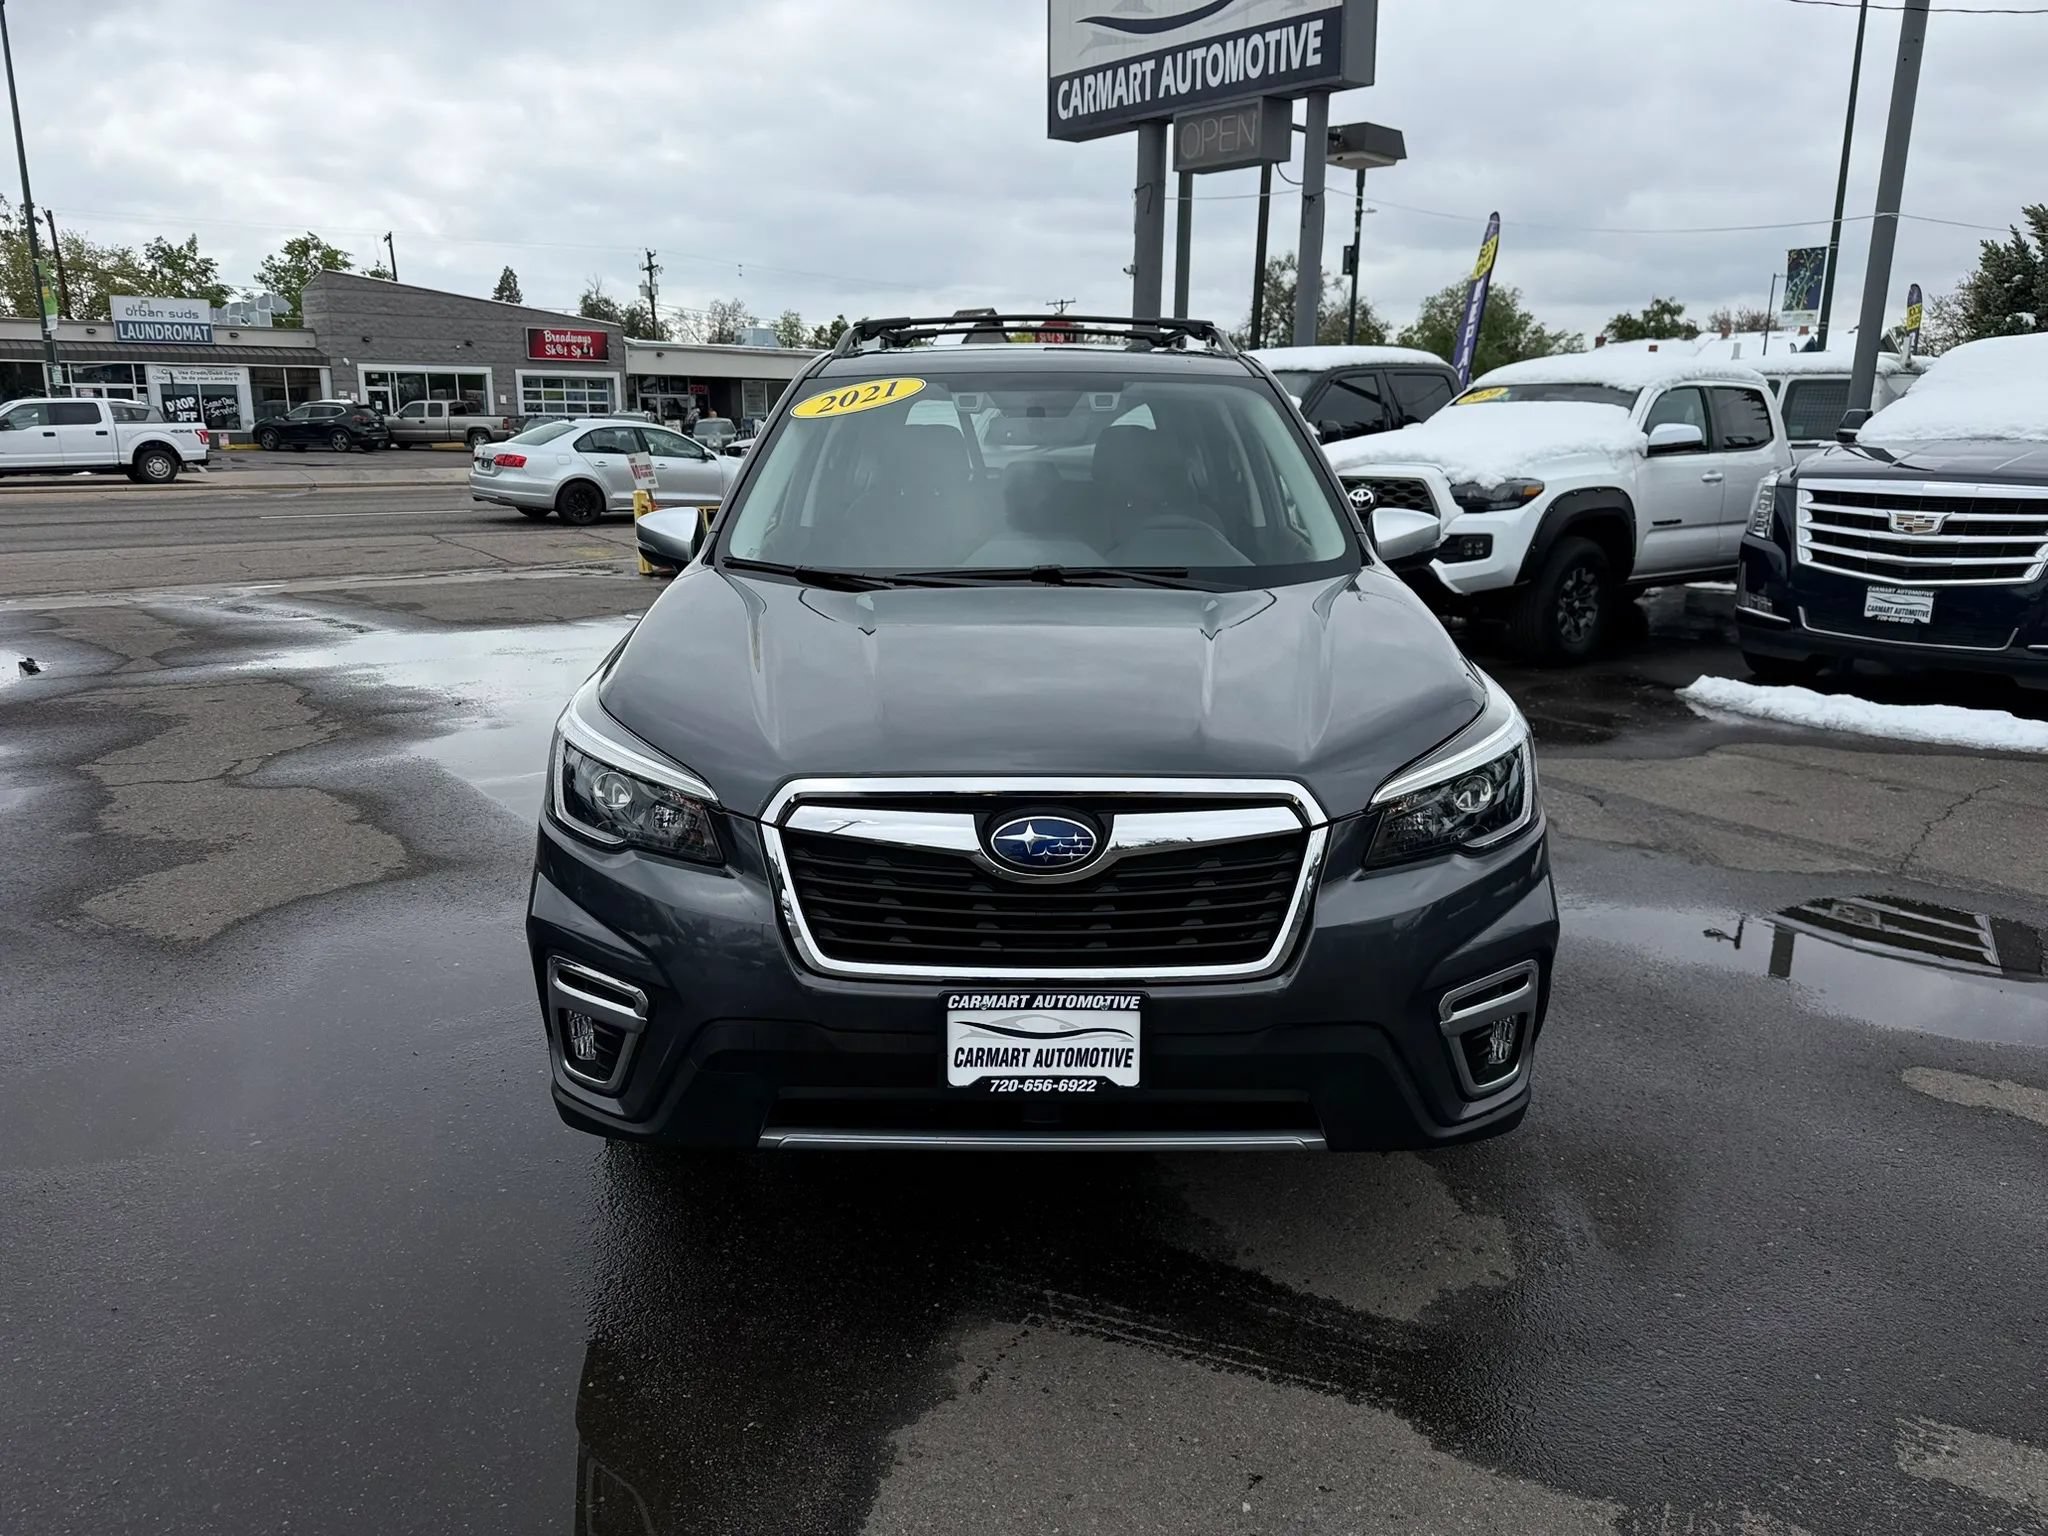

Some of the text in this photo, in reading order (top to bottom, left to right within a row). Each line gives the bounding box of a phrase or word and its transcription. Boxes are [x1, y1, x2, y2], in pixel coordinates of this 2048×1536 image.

[1057, 19, 1324, 120] CARMART AUTOMOTIVE
[1179, 111, 1257, 160] OPEN
[168, 309, 200, 320] suds
[118, 323, 209, 341] LAUNDROMAT
[165, 396, 196, 413] DROP
[816, 381, 899, 414] 2021
[1867, 585, 1935, 597] CARMART AUTOMOTIVE
[1867, 604, 1930, 618] CARMART AUTOMOTIVE
[947, 995, 1141, 1009] CARMART AUTOMOTIVE
[953, 1047, 1135, 1068] CARMART AUTOMOTIVE
[990, 1079, 1098, 1093] 720-656-6922
